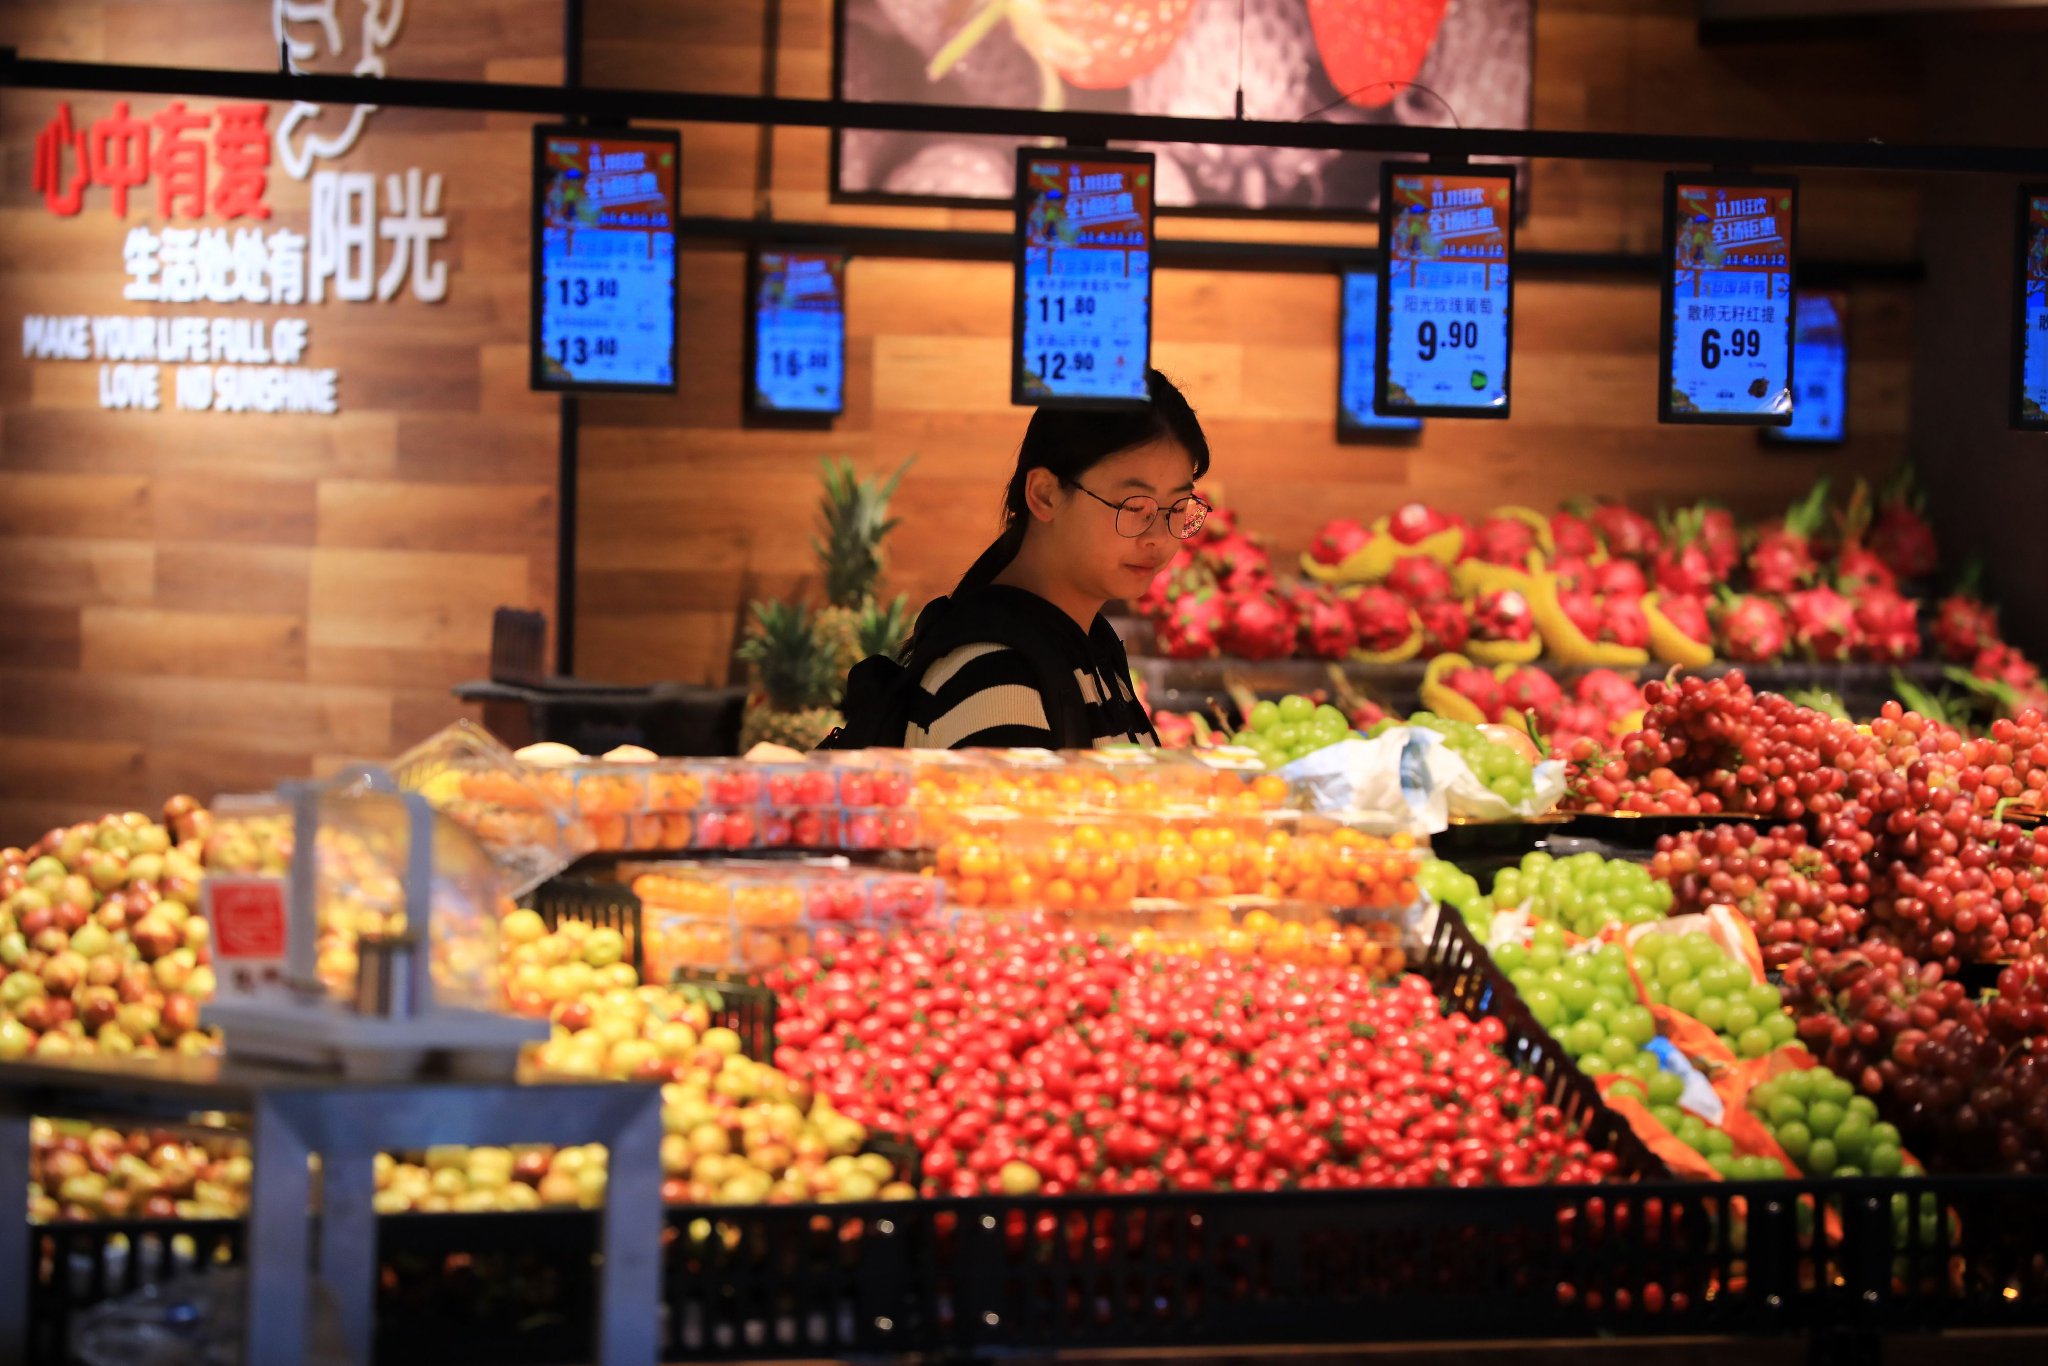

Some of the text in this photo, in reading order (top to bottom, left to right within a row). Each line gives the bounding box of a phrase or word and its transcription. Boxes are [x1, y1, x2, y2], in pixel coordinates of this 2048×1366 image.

[31, 100, 272, 220] 心中有爱
[1404, 295, 1494, 314] 阳光玫瑰葡萄
[1688, 305, 1776, 323] 散称无籽红提
[23, 314, 310, 364] MAKE YOUR LIFE FULL OF
[1418, 320, 1478, 361] 9.90
[1701, 328, 1760, 369] 6.99
[99, 365, 339, 414] LOVE NO SUNSHINE
